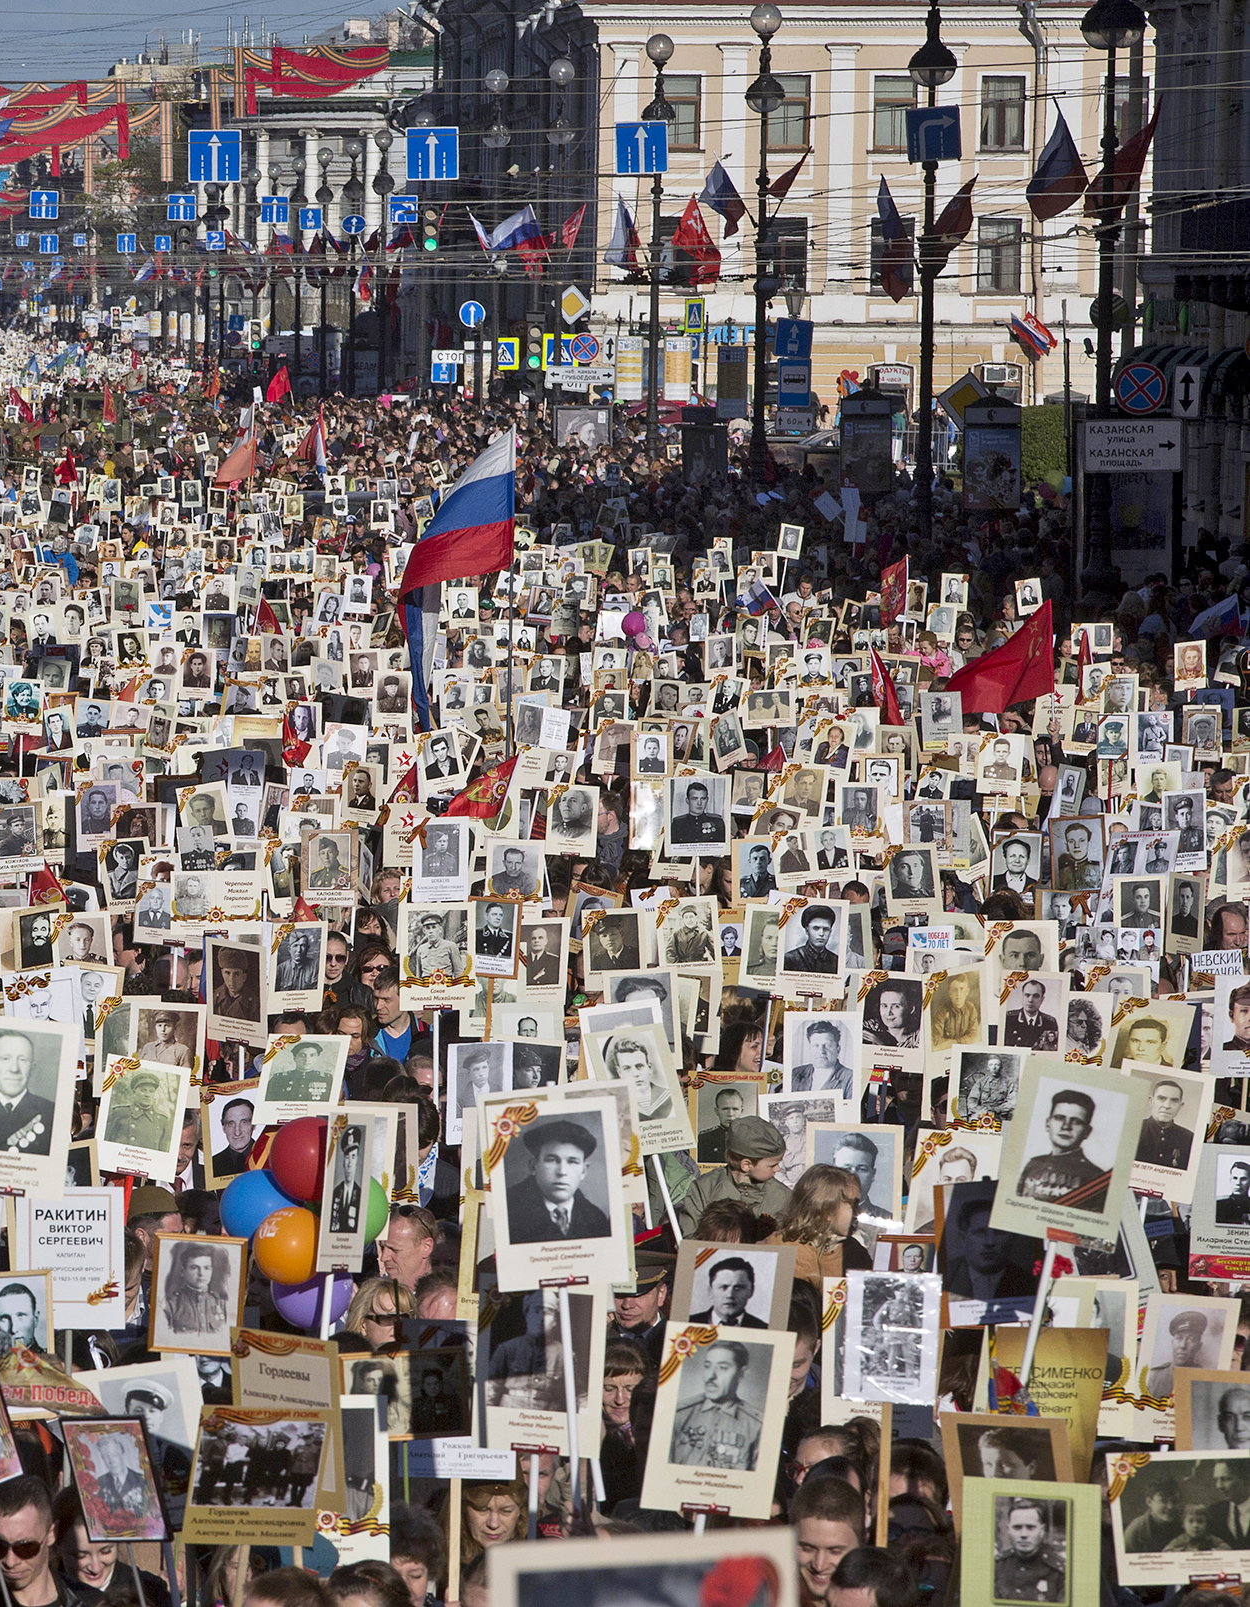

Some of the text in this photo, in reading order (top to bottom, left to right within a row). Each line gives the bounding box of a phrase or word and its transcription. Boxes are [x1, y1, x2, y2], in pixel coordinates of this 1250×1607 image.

[786, 417, 797, 425] 60
[1090, 425, 1154, 434] КАЗАНСКАЯ
[1107, 436, 1135, 445] улица
[1090, 449, 1154, 457] КАЗАНСКАЯ
[1100, 460, 1143, 468] площадь
[928, 932, 950, 940] ПОБЕДА!
[928, 940, 949, 949] 70 ЛЕТ
[1193, 950, 1242, 967] НЕВСКИЙ
[638, 1123, 663, 1131] Гриднев
[648, 1127, 684, 1138] Степанович
[1153, 1167, 1183, 1177] АНДРЕЕВИЧ
[35, 1209, 107, 1222] РАКИТИН
[49, 1224, 93, 1233] ВИКТОР
[38, 1237, 103, 1246] СЕРГЕЕВИЧ
[1196, 1236, 1233, 1244] Илларион
[540, 1244, 582, 1253] Решетников
[529, 1253, 559, 1263] Григорий
[304, 1341, 326, 1354] ПОЛК
[259, 1362, 311, 1382] Гордеевы
[242, 1389, 330, 1408] Александр Александрович
[294, 1409, 319, 1419] ПОЛК
[508, 1420, 534, 1429] Никита
[442, 1442, 472, 1450] Рожков
[458, 1452, 509, 1461] Григорьевич
[208, 1508, 250, 1518] Гордеева
[190, 1517, 306, 1527] Антонина Александровна
